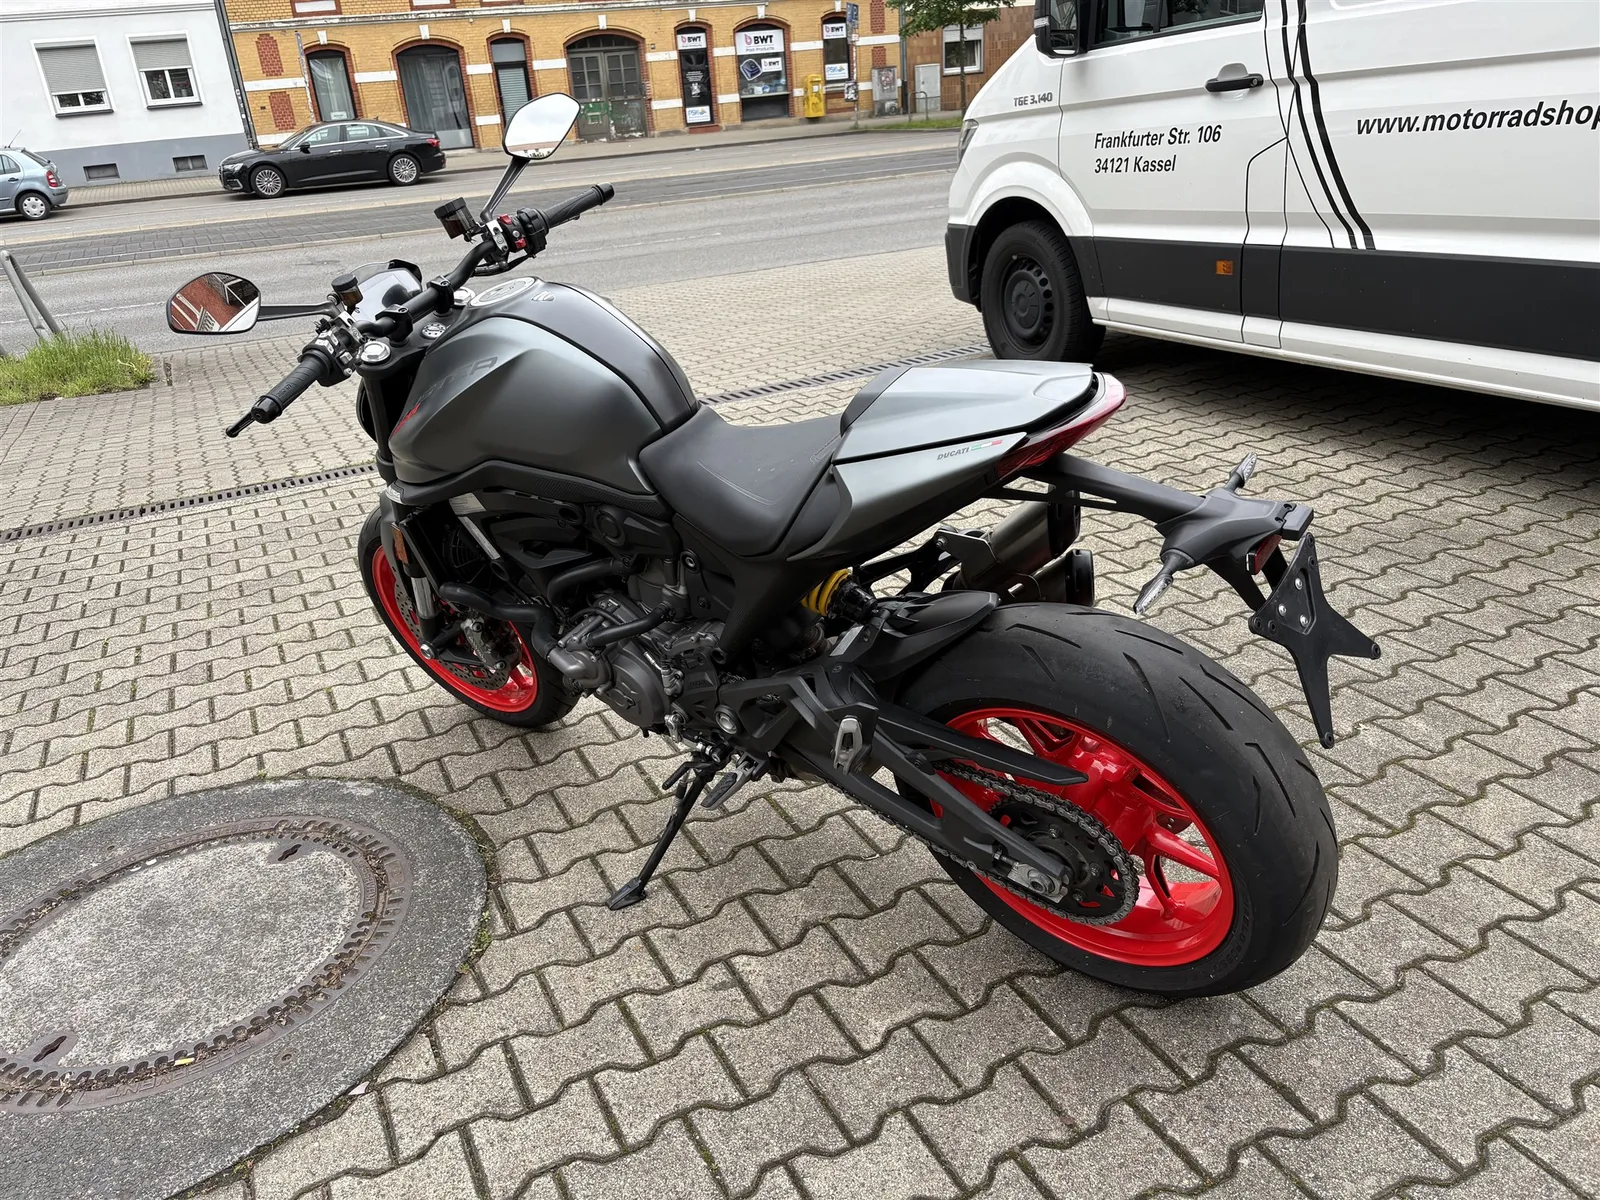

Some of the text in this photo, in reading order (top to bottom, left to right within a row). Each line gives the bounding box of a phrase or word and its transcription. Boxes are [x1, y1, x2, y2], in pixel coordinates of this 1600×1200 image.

[687, 35, 702, 43] BWT
[753, 35, 774, 45] BWT
[1014, 91, 1053, 107] TGE 3.140
[1094, 124, 1222, 149] Frankfurter Str. 106
[1094, 155, 1177, 174] 34121 Kassel
[937, 446, 970, 461] DUCATI
